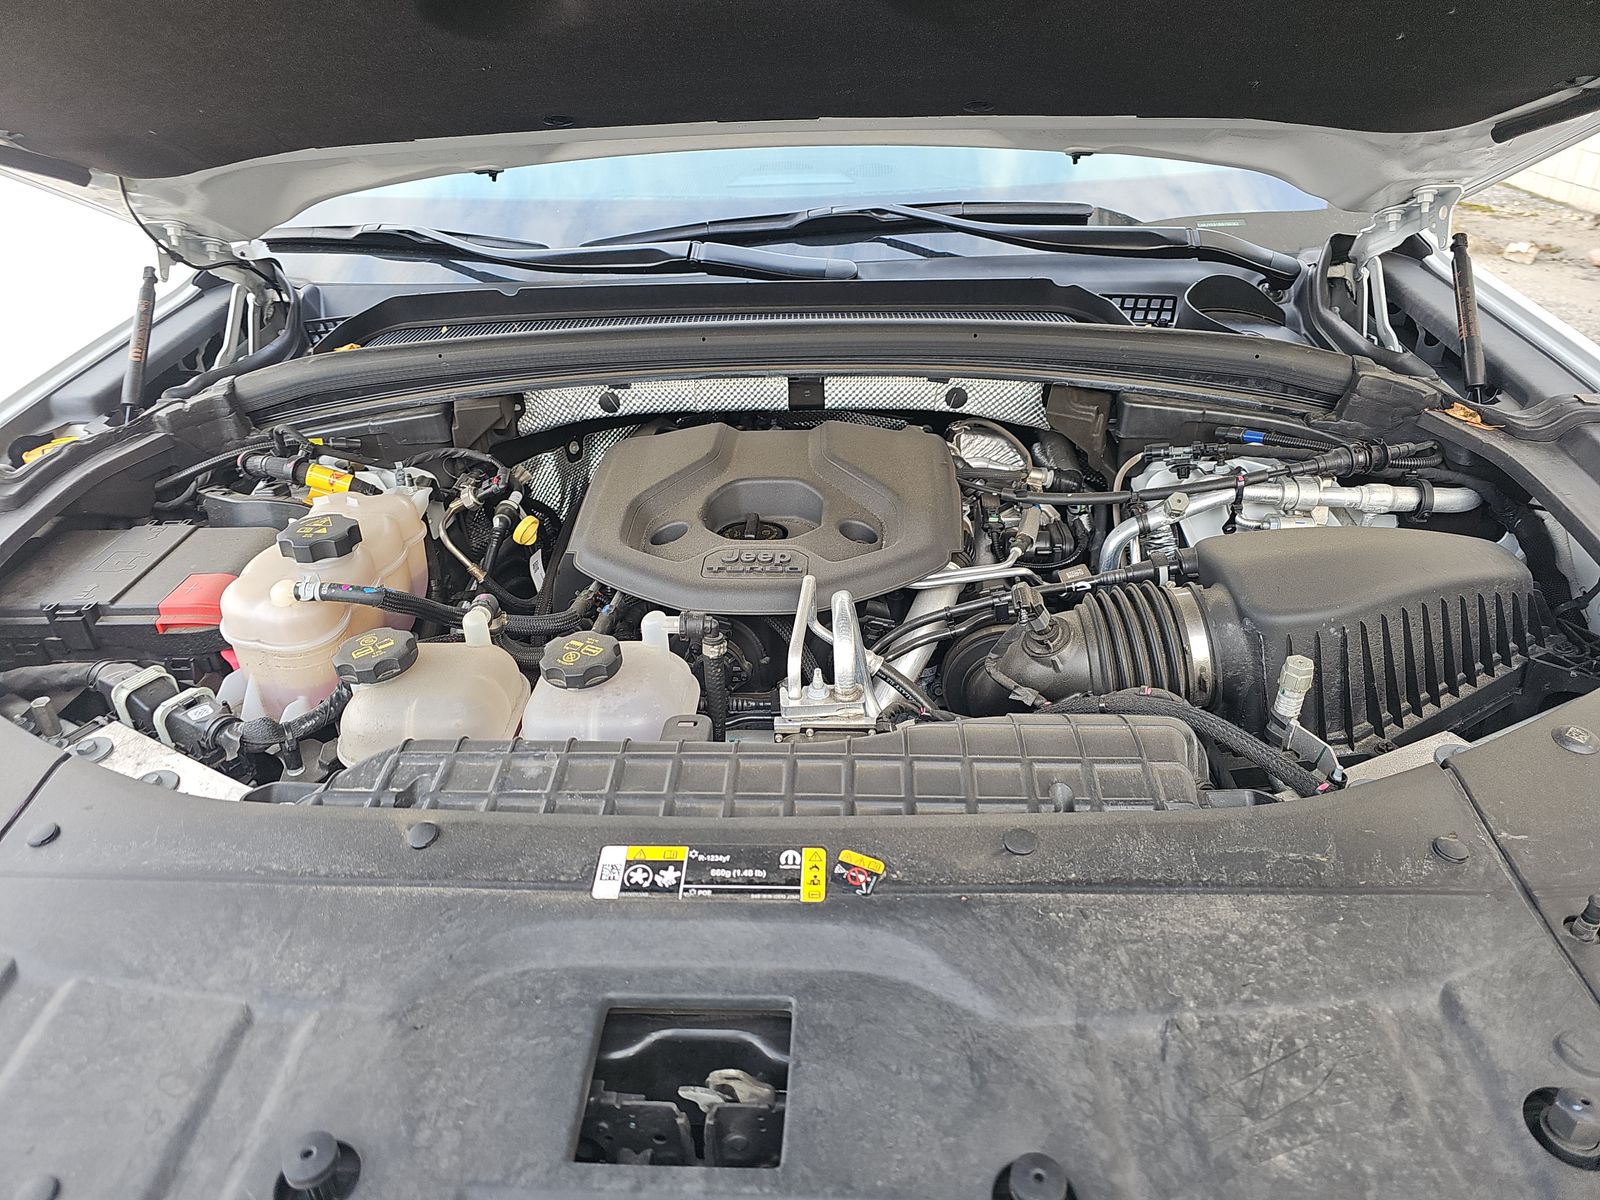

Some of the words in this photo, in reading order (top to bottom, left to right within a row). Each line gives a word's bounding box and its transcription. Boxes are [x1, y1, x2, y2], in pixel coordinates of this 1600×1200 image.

[721, 548, 792, 566] Jeep
[705, 566, 803, 574] TURBO
[697, 854, 731, 864] R-1234yf
[754, 868, 767, 879] lb)
